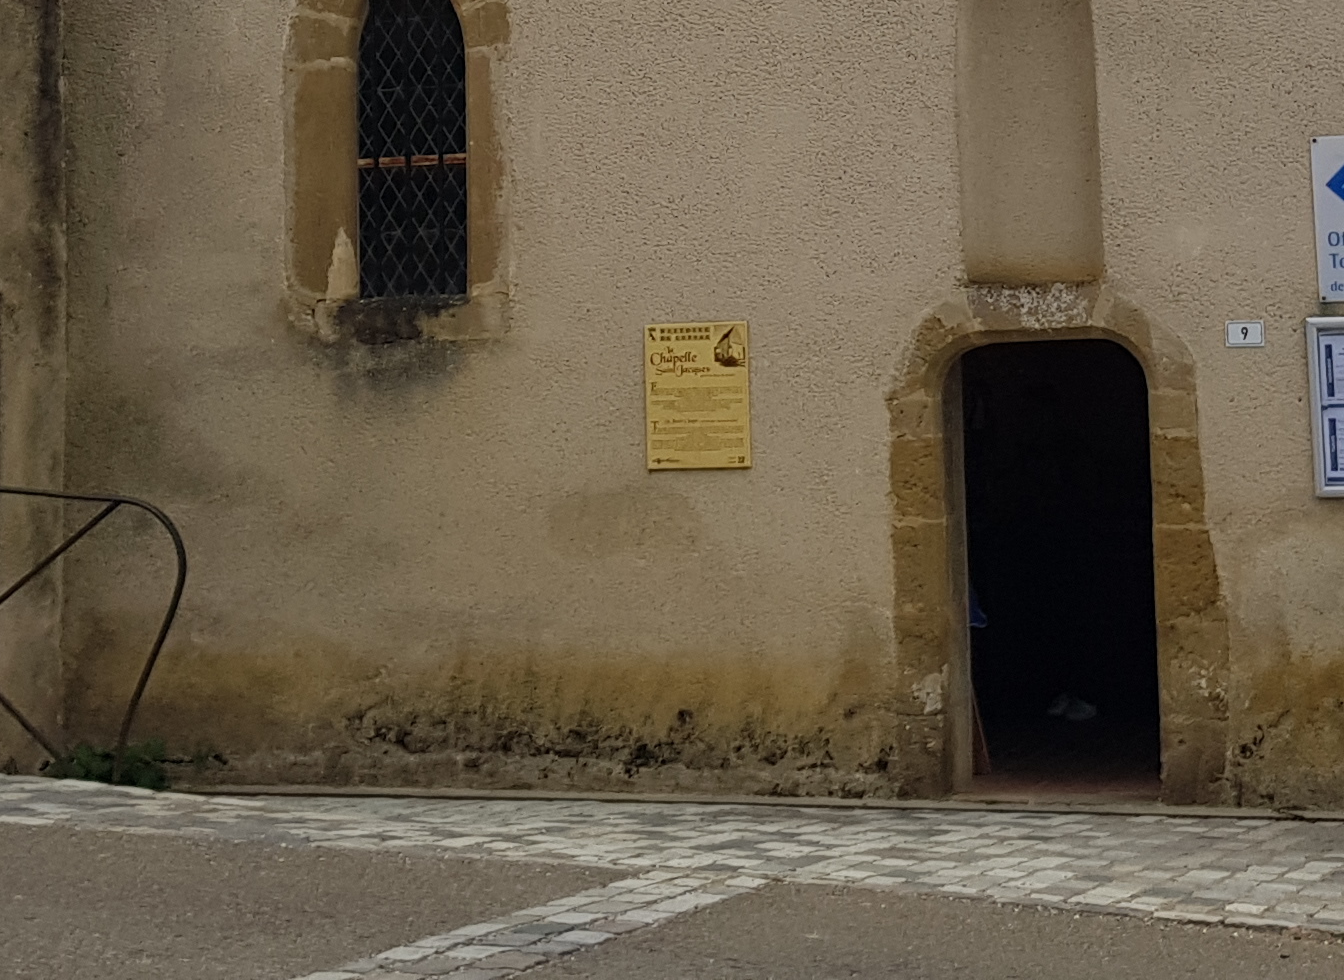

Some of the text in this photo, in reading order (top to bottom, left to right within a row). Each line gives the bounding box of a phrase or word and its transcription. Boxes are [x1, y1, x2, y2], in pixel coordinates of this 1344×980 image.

[1330, 280, 1344, 292] de
[1240, 326, 1249, 341] 9
[649, 351, 698, 372] Chapelle
